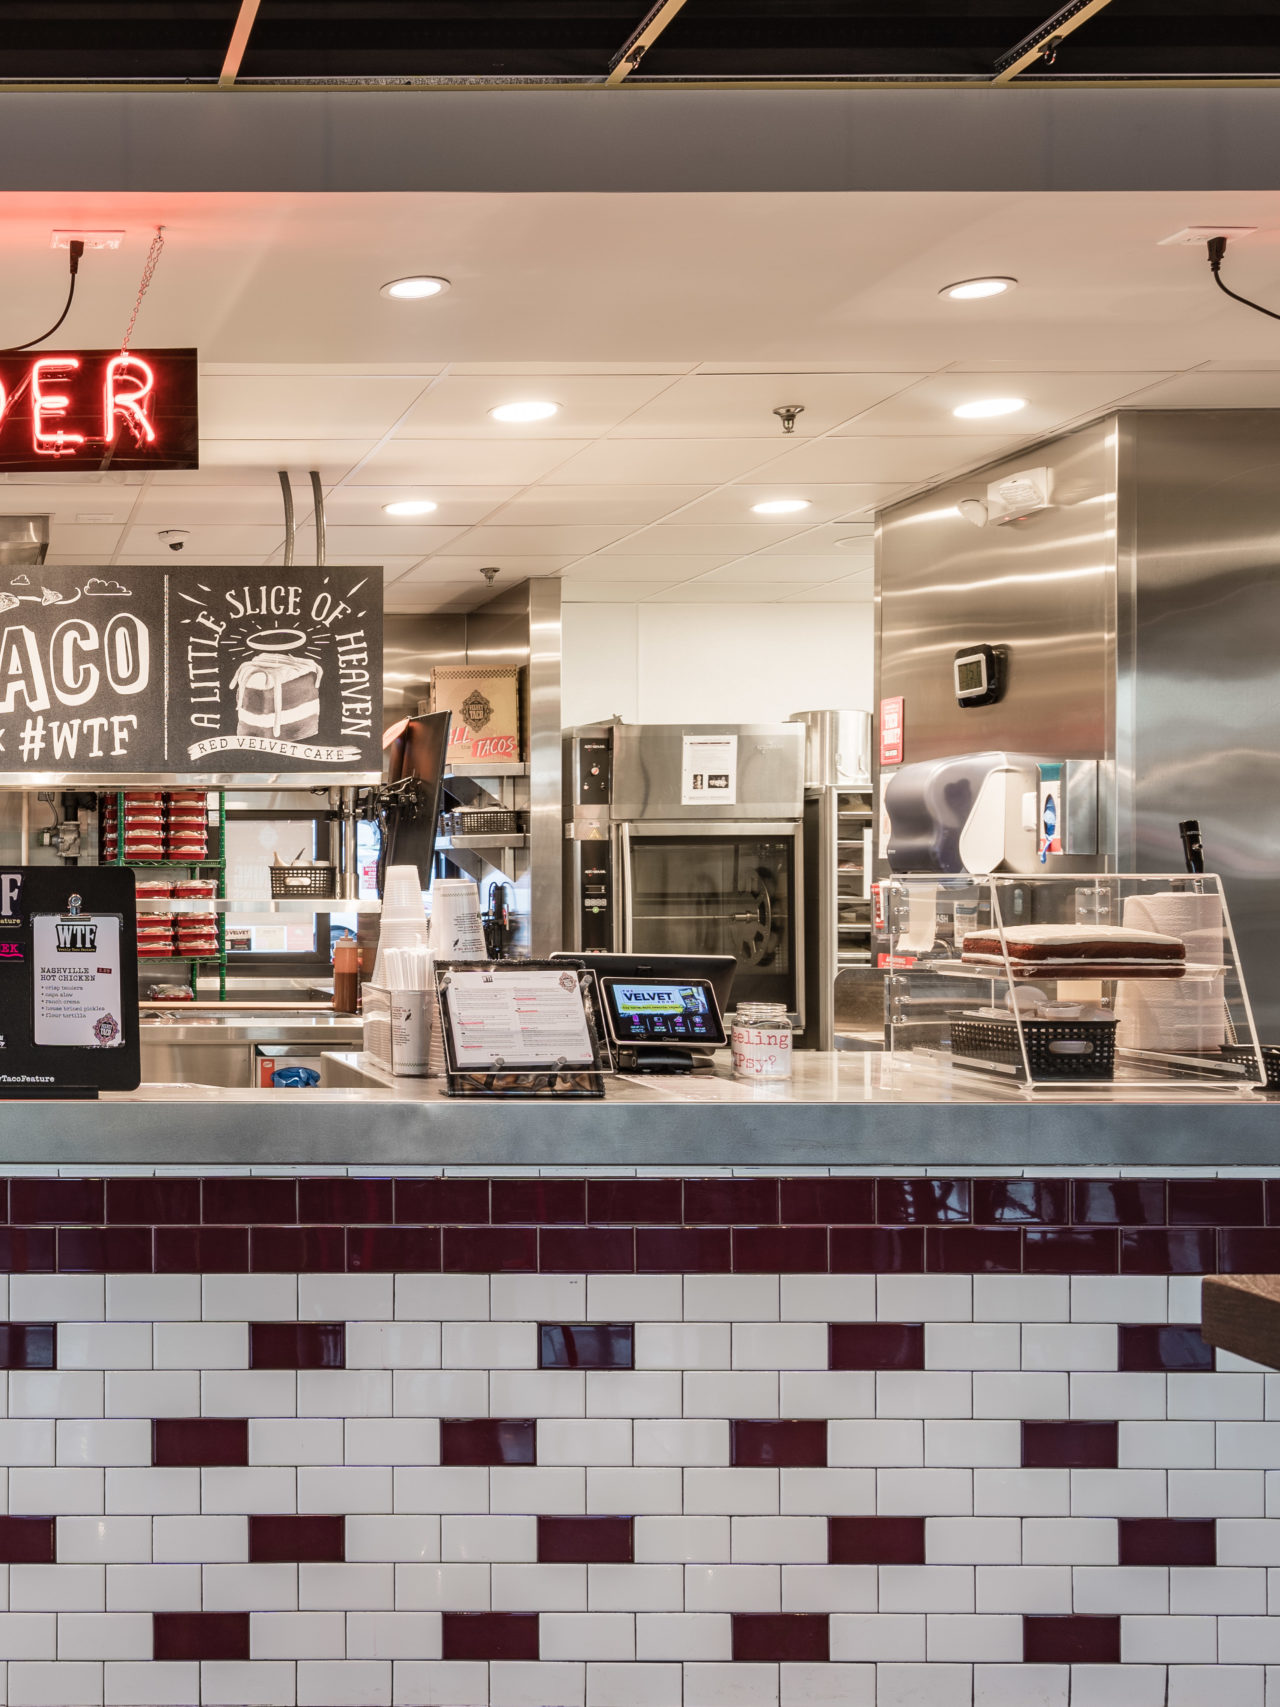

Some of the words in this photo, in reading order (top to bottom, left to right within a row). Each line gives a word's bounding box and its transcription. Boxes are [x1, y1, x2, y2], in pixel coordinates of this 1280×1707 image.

[224, 585, 303, 620] SLICE
[310, 592, 352, 628] OF
[187, 609, 228, 707] LITTLE
[334, 629, 374, 740] HEAVEN
[190, 712, 220, 730] A
[18, 714, 138, 763] #WTF
[198, 738, 229, 754] RED
[236, 738, 298, 756] VELVET
[303, 747, 345, 761] CAKE
[477, 738, 514, 756] TACOS
[936, 915, 949, 924] ASH
[57, 925, 96, 947] WTF
[58, 974, 96, 982] CHICKEN
[624, 993, 673, 1001] VELVET
[732, 1030, 789, 1049] eeling
[733, 1051, 777, 1073] Psy?
